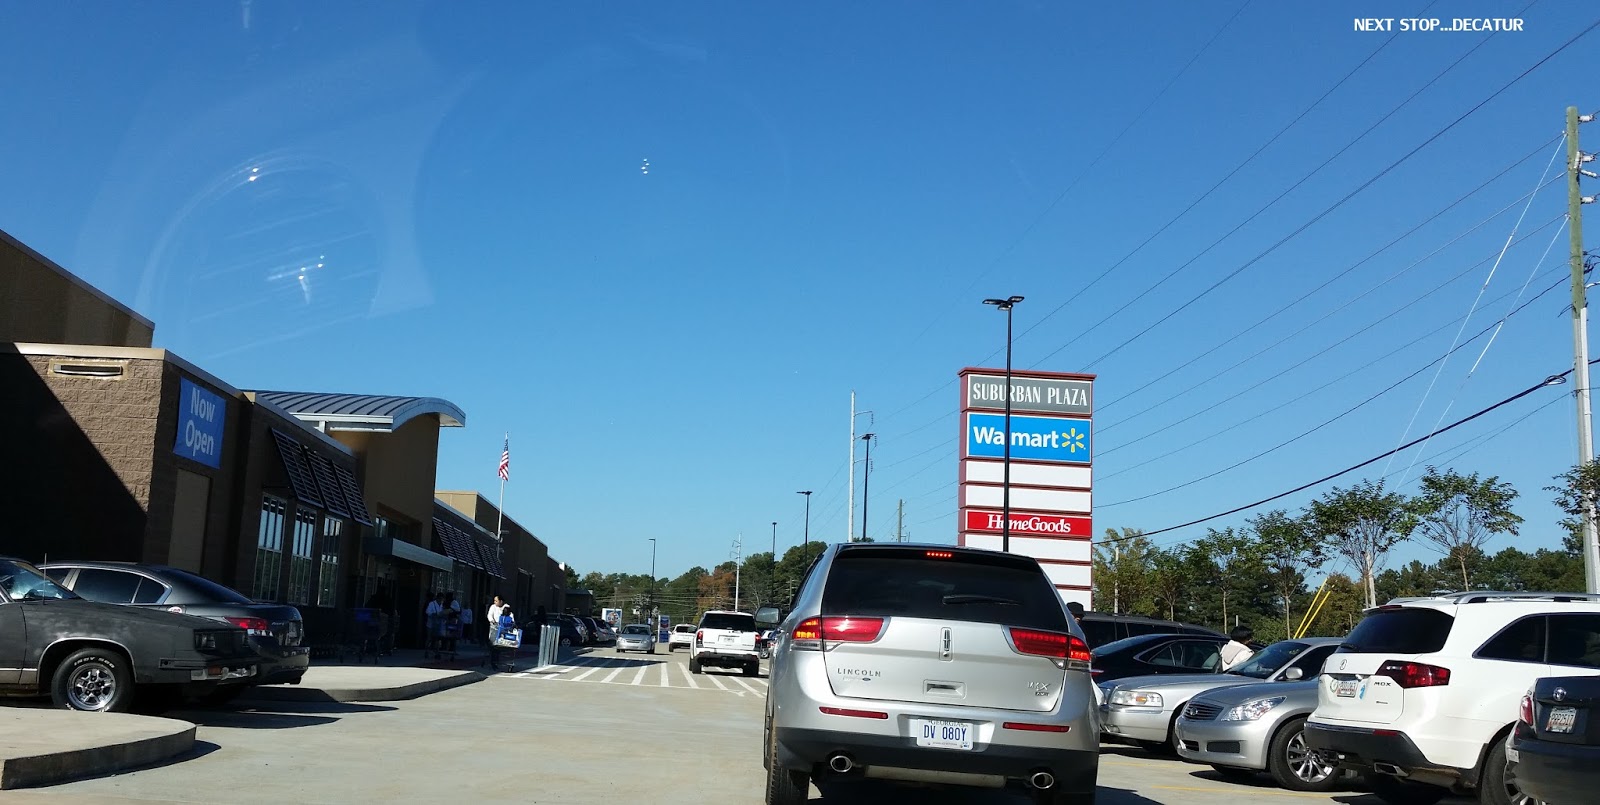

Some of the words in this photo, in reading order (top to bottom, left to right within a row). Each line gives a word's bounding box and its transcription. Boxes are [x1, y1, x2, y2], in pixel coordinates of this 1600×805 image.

[190, 386, 216, 423] Now
[972, 382, 1041, 403] SUBURBAN
[1047, 387, 1088, 406] PLAZA
[185, 419, 215, 457] Open
[973, 426, 1059, 448] Wamart
[73, 656, 96, 666] INDY
[837, 667, 881, 678] LINCOLN
[923, 724, 936, 739] DV
